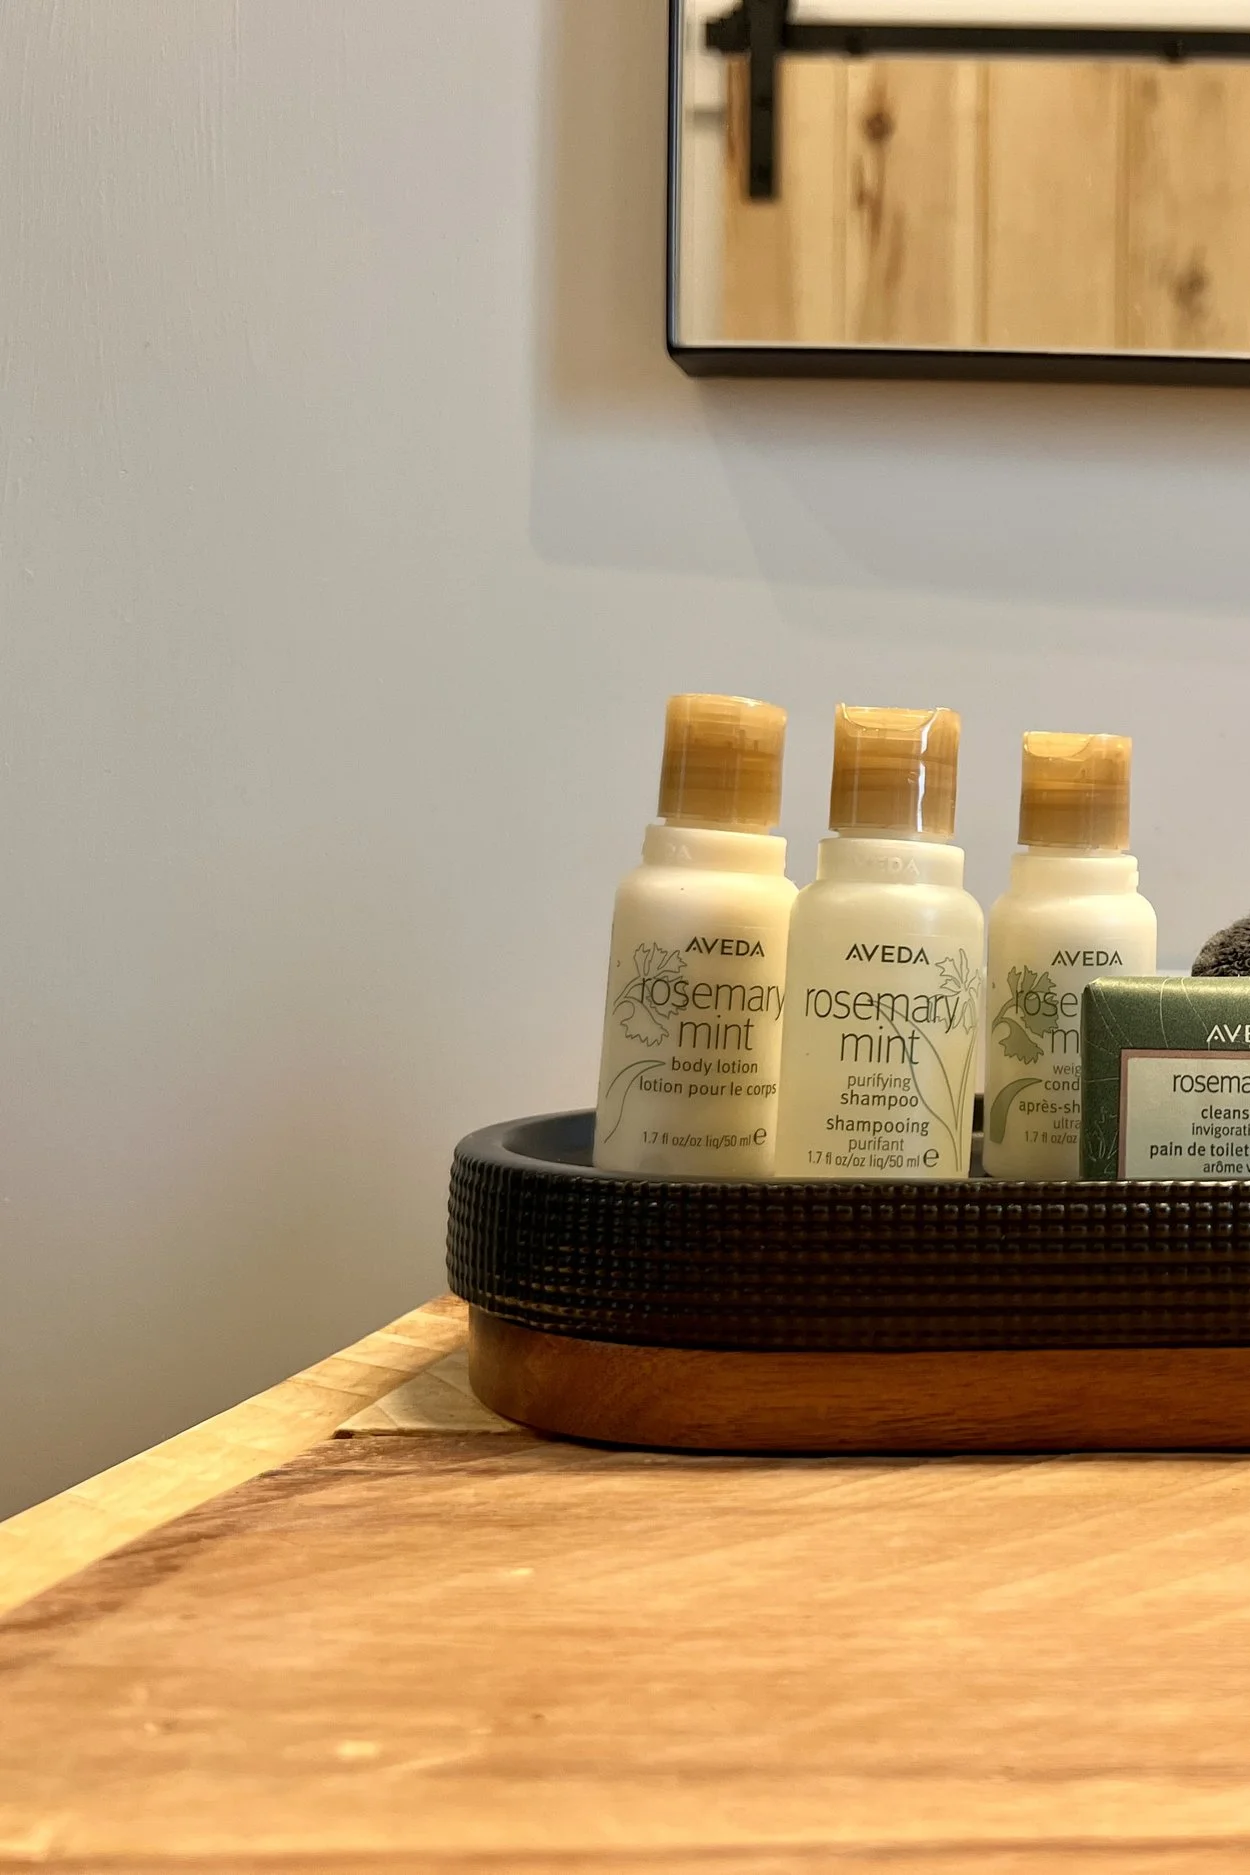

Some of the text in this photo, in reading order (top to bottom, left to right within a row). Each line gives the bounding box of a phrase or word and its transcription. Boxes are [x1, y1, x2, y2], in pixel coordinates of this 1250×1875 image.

[685, 936, 765, 957] AVEDA
[845, 944, 930, 965] AVEDA
[1051, 950, 1123, 966] AVEDA
[641, 977, 785, 1021] rosemary
[805, 987, 960, 1033] rosemary
[679, 1015, 755, 1051] mint
[840, 1025, 920, 1065] mint
[671, 1057, 758, 1076] body lotion
[639, 1076, 777, 1098] lotion pour le corps
[847, 1073, 911, 1091] purifying
[840, 1090, 919, 1110] shampoo
[826, 1115, 930, 1137] shampooing
[643, 1131, 659, 1144] 1.7
[662, 1132, 669, 1145] fl
[672, 1134, 702, 1148] oz/oz
[705, 1134, 737, 1150] liq/50
[740, 1135, 751, 1147] ml
[848, 1135, 905, 1153] purifant
[1025, 1132, 1078, 1145] 1.7 fl oz/oz
[807, 1150, 823, 1164] 1.7
[826, 1152, 832, 1165] fl
[835, 1153, 865, 1168] oz/oz
[869, 1154, 904, 1170] liq/50
[906, 1155, 920, 1168] ml
[1150, 1142, 1183, 1160] pain
[1187, 1143, 1206, 1156] de
[1203, 1161, 1243, 1173] arôme
